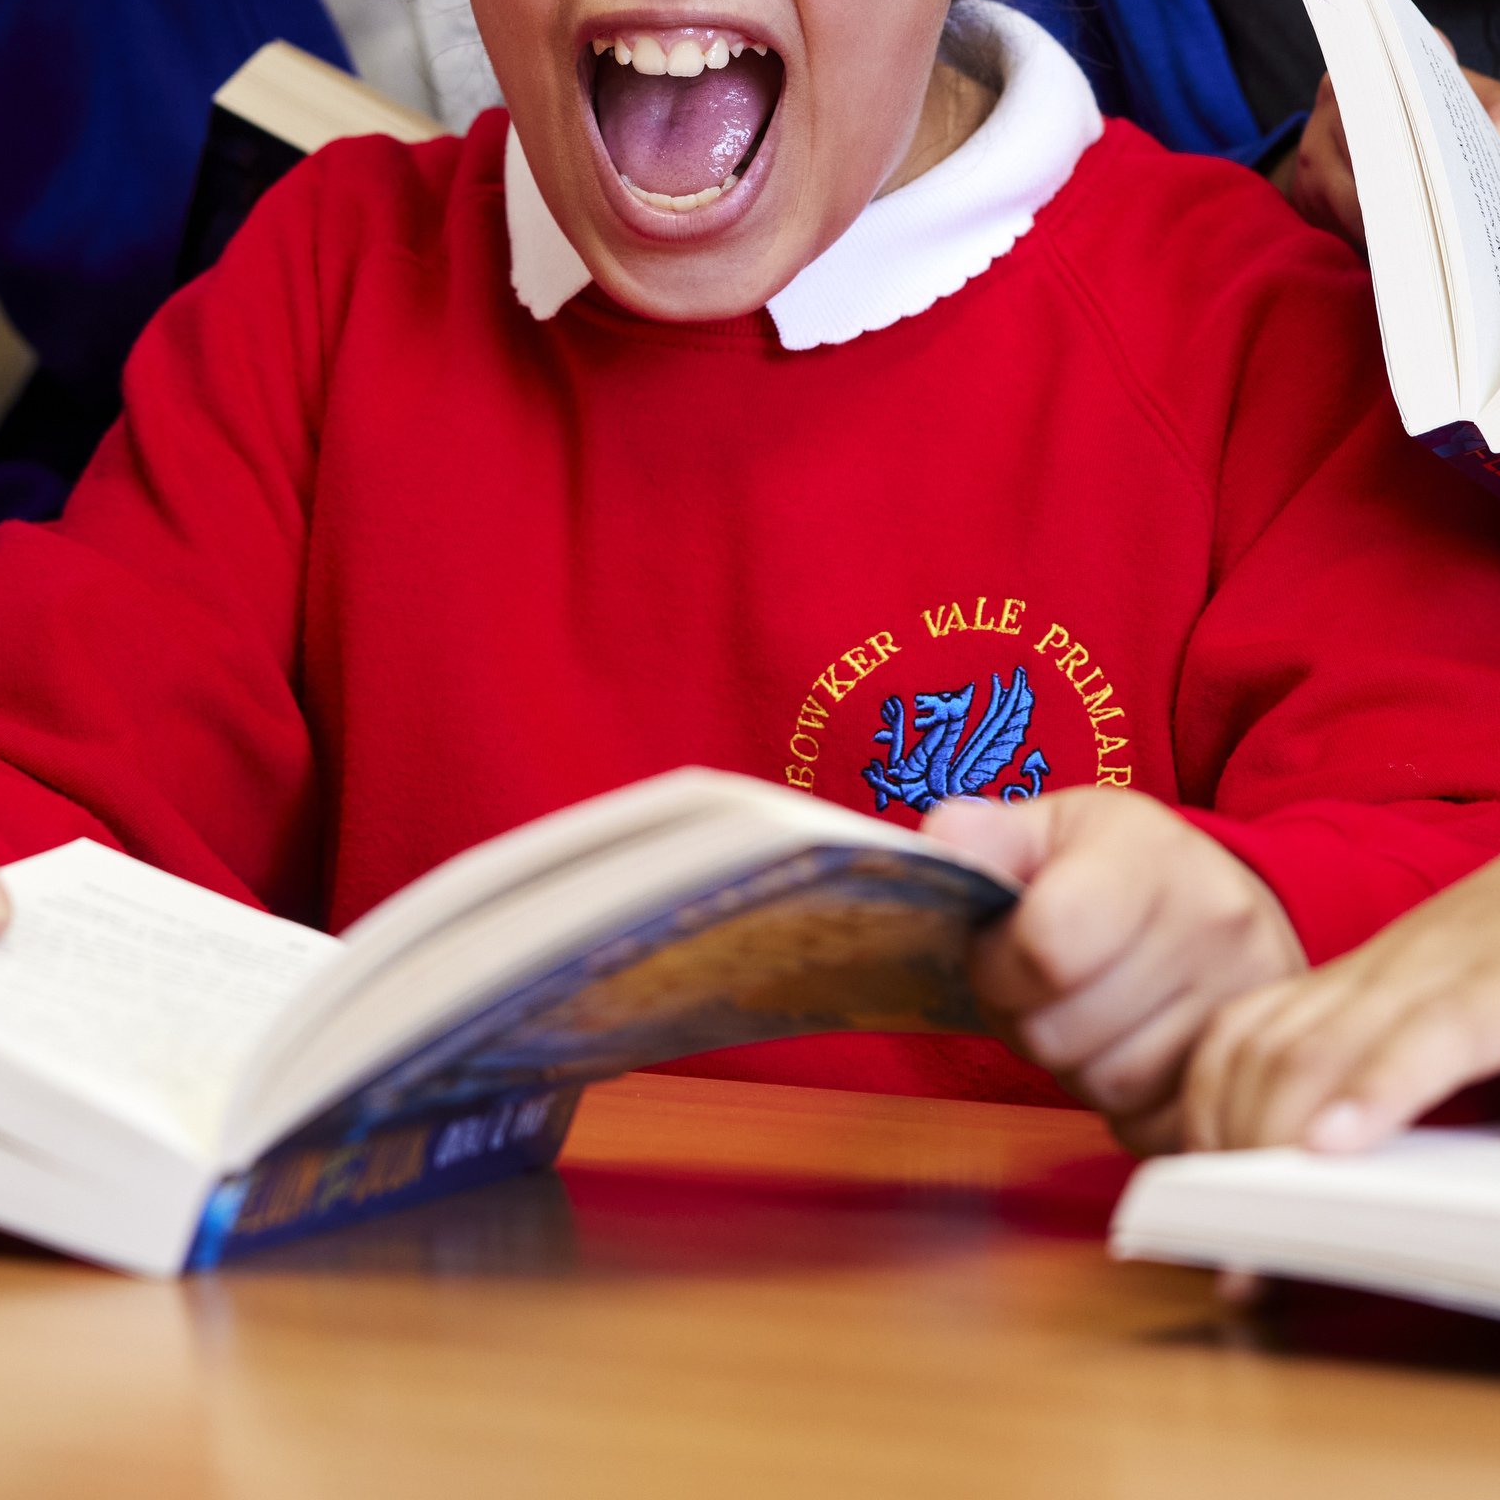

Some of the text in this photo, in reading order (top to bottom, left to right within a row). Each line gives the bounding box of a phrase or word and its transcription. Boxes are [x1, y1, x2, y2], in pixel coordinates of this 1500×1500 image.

[786, 596, 1134, 794] BOWKER VALE PRIMAR
